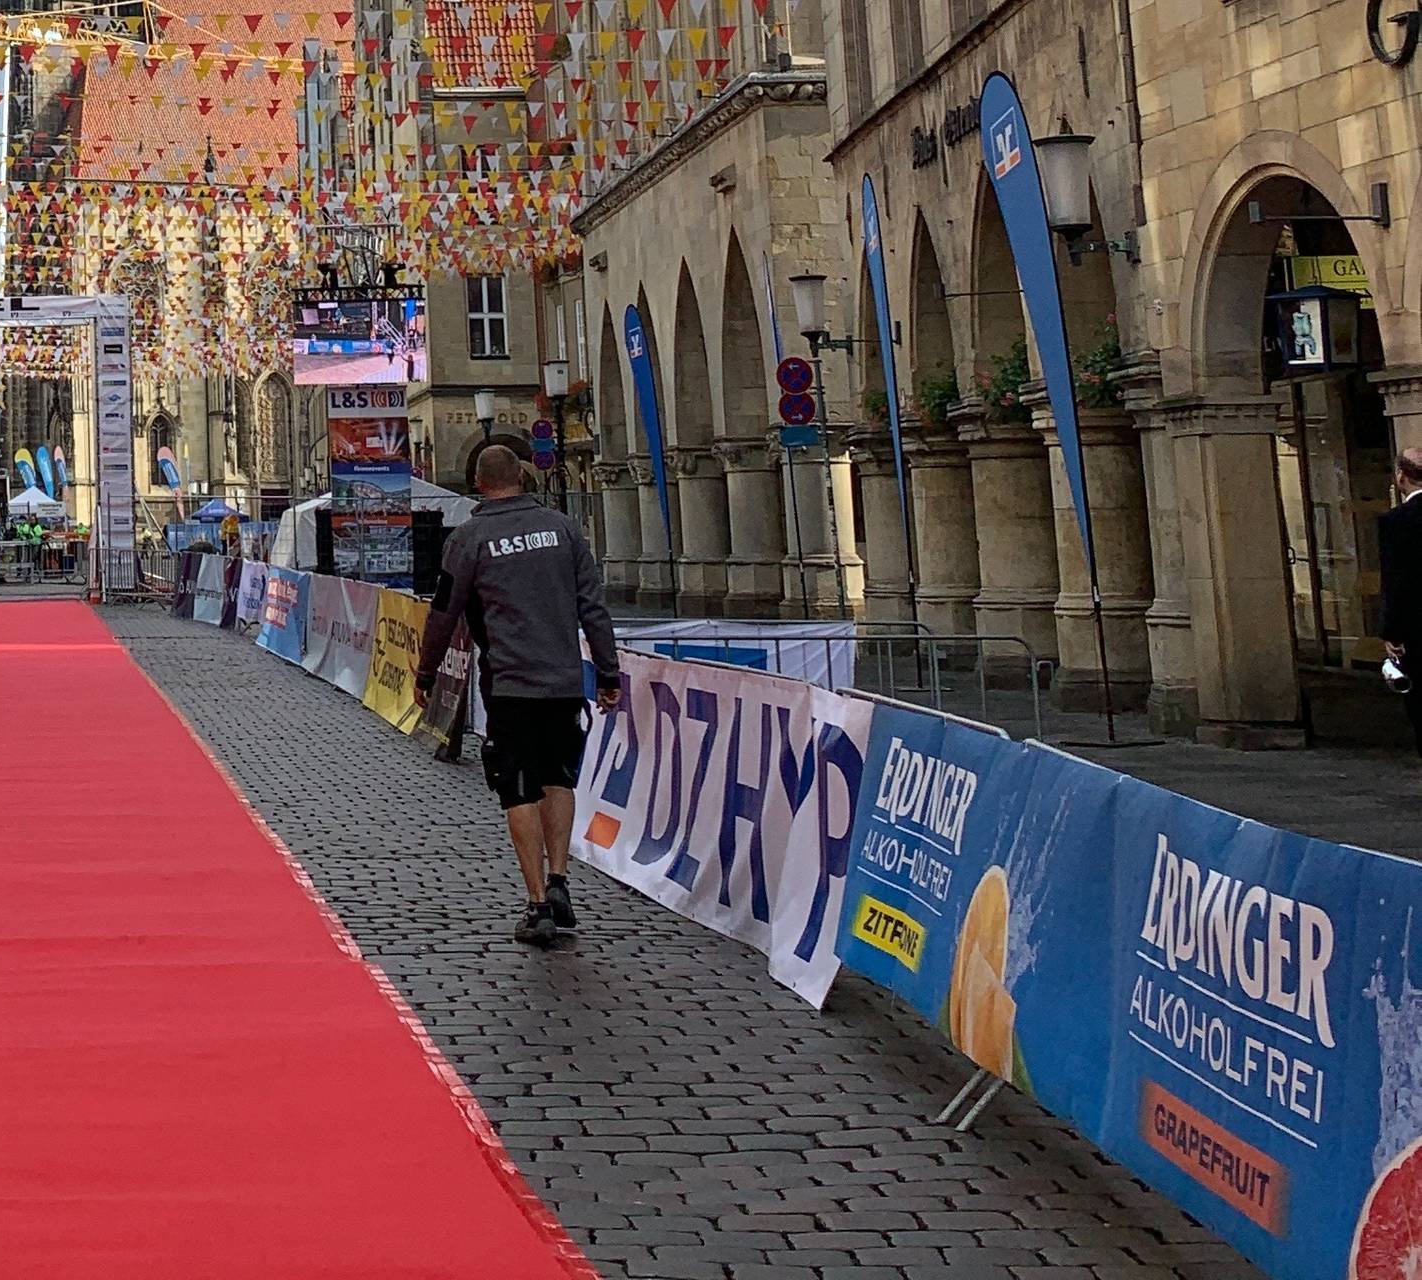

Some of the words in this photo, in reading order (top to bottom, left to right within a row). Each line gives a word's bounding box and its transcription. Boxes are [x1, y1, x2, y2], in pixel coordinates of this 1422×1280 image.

[331, 391, 369, 408] L&S
[446, 412, 528, 424] PETOLD
[488, 535, 525, 558] L&S
[876, 737, 978, 856] ERDINGER
[861, 829, 953, 901] ALKOHOLFREI
[863, 907, 919, 958] ZITRONE
[1141, 832, 1336, 1048] ERDINGER
[1129, 975, 1324, 1124] ALKOHOLFREI
[1154, 1103, 1271, 1207] GRAPEFRUIT
